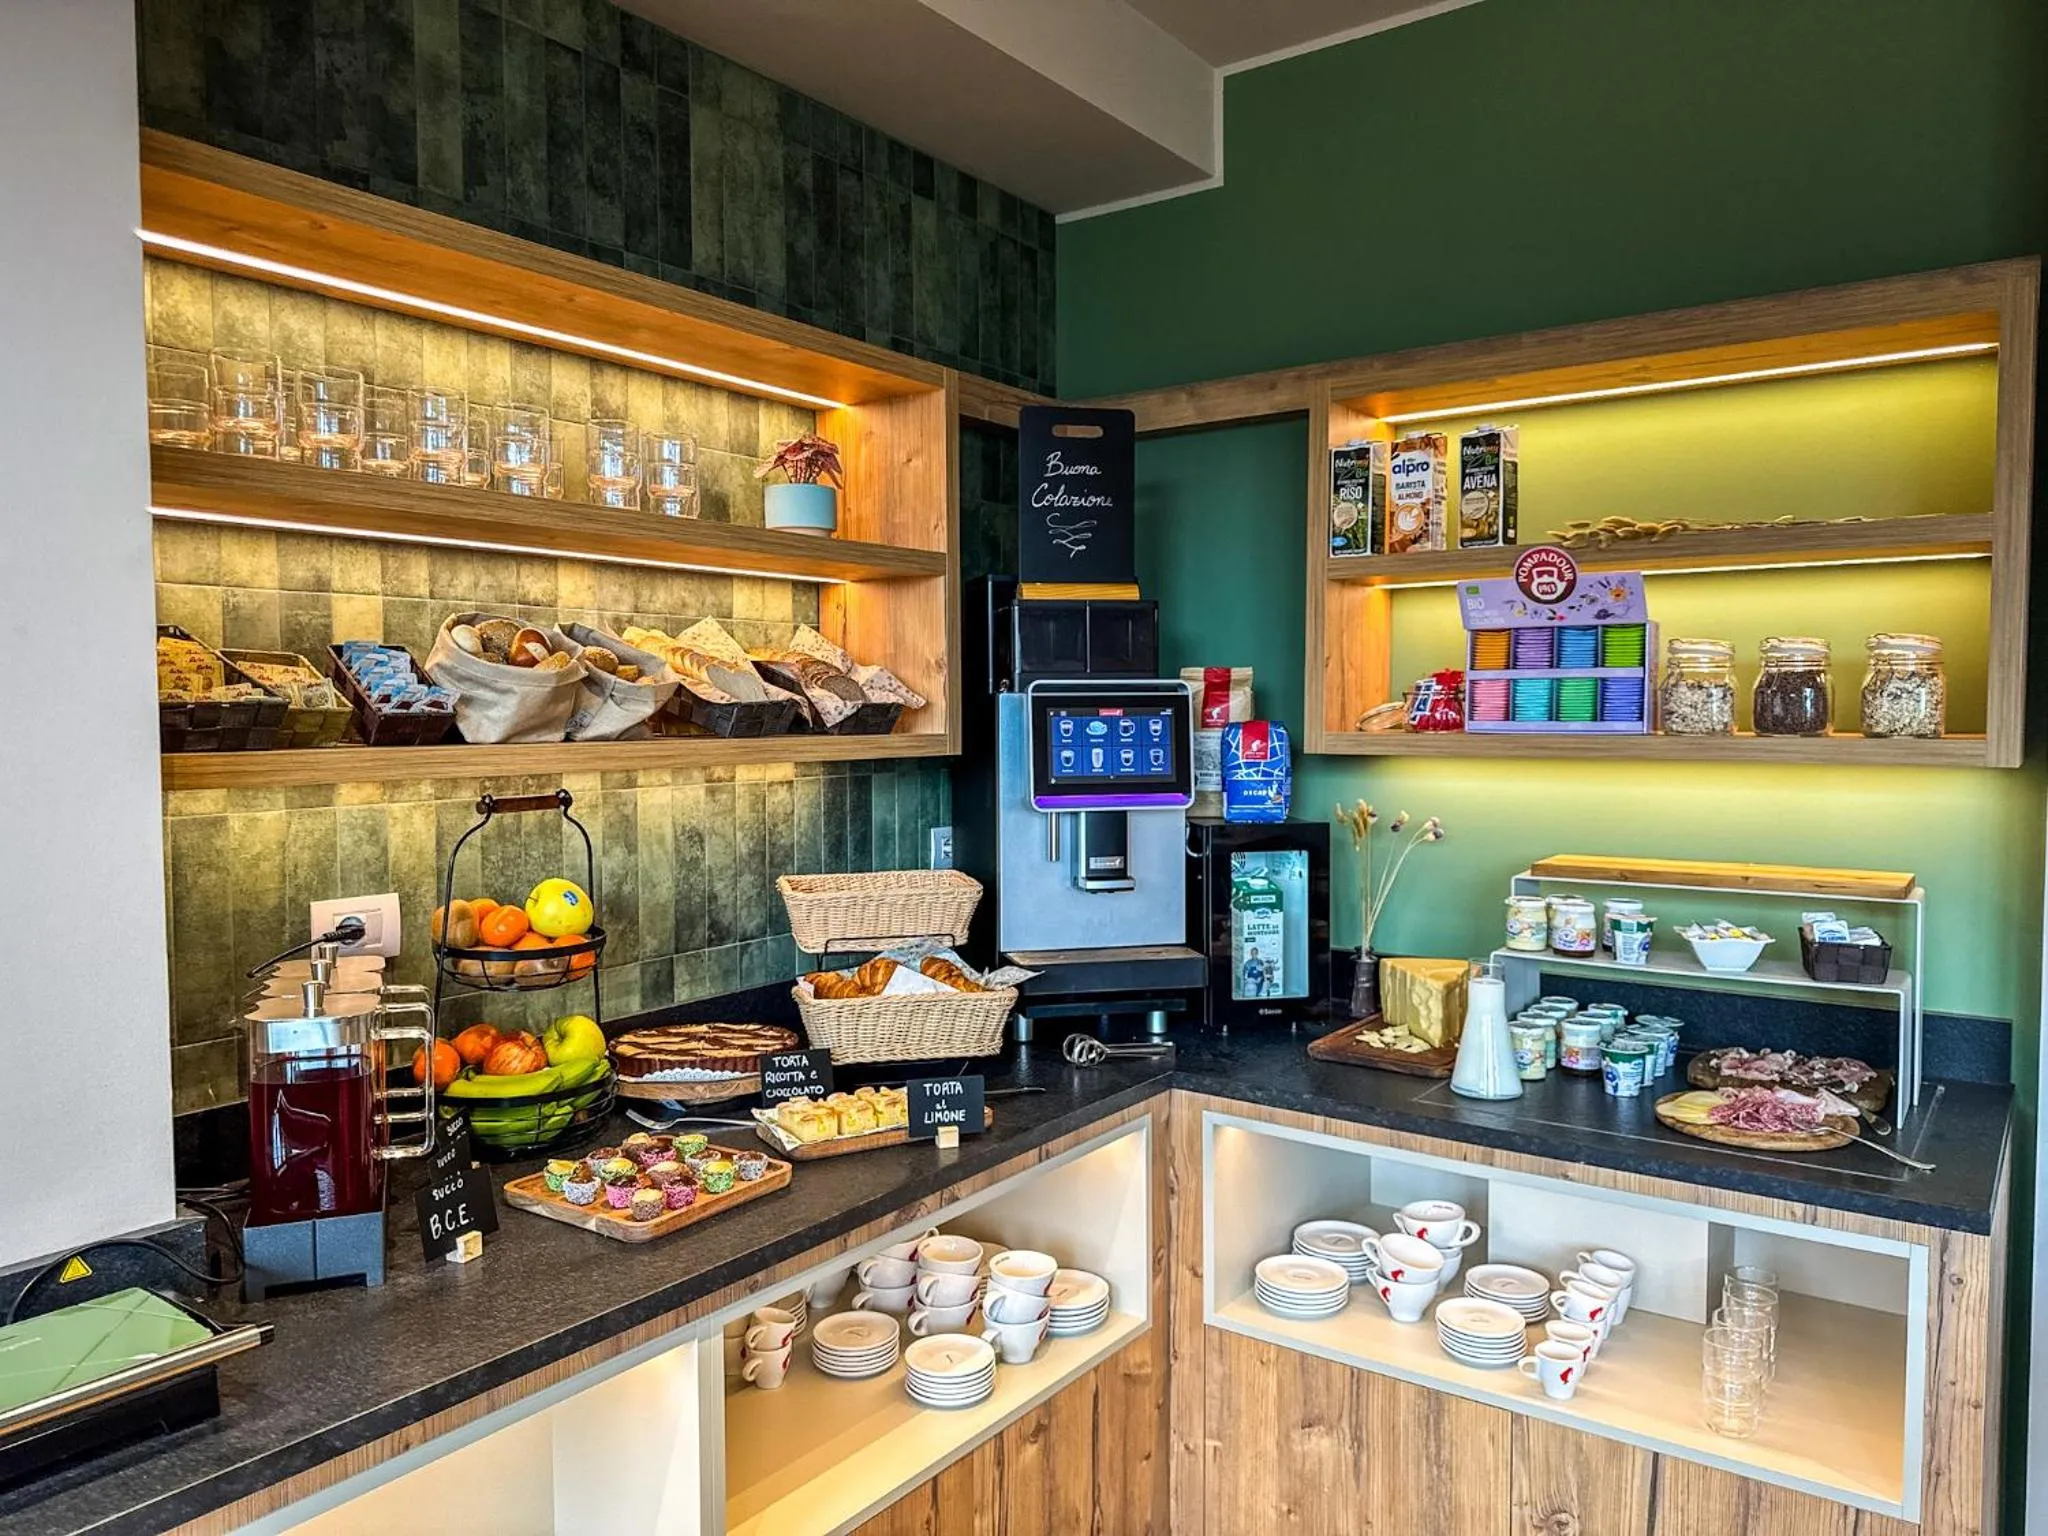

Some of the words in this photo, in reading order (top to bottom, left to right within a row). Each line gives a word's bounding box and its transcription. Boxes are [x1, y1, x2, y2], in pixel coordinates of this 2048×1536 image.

[1044, 451, 1102, 477] Buona
[1391, 458, 1430, 478] alpro
[1463, 473, 1497, 490] AVENA
[1031, 483, 1113, 508] Colazione
[1340, 486, 1363, 500] RISO
[1518, 552, 1575, 583] POMPADOUR
[1466, 598, 1485, 610] BIO
[771, 1054, 809, 1068] TORTA
[765, 1070, 805, 1084] RICOTTA
[765, 1084, 825, 1099] CIOCCOLATO
[923, 1081, 964, 1097] TORTA
[924, 1109, 966, 1124] LIMONE
[432, 1178, 464, 1201] SUCCO
[429, 1203, 474, 1241] B.C.E.
